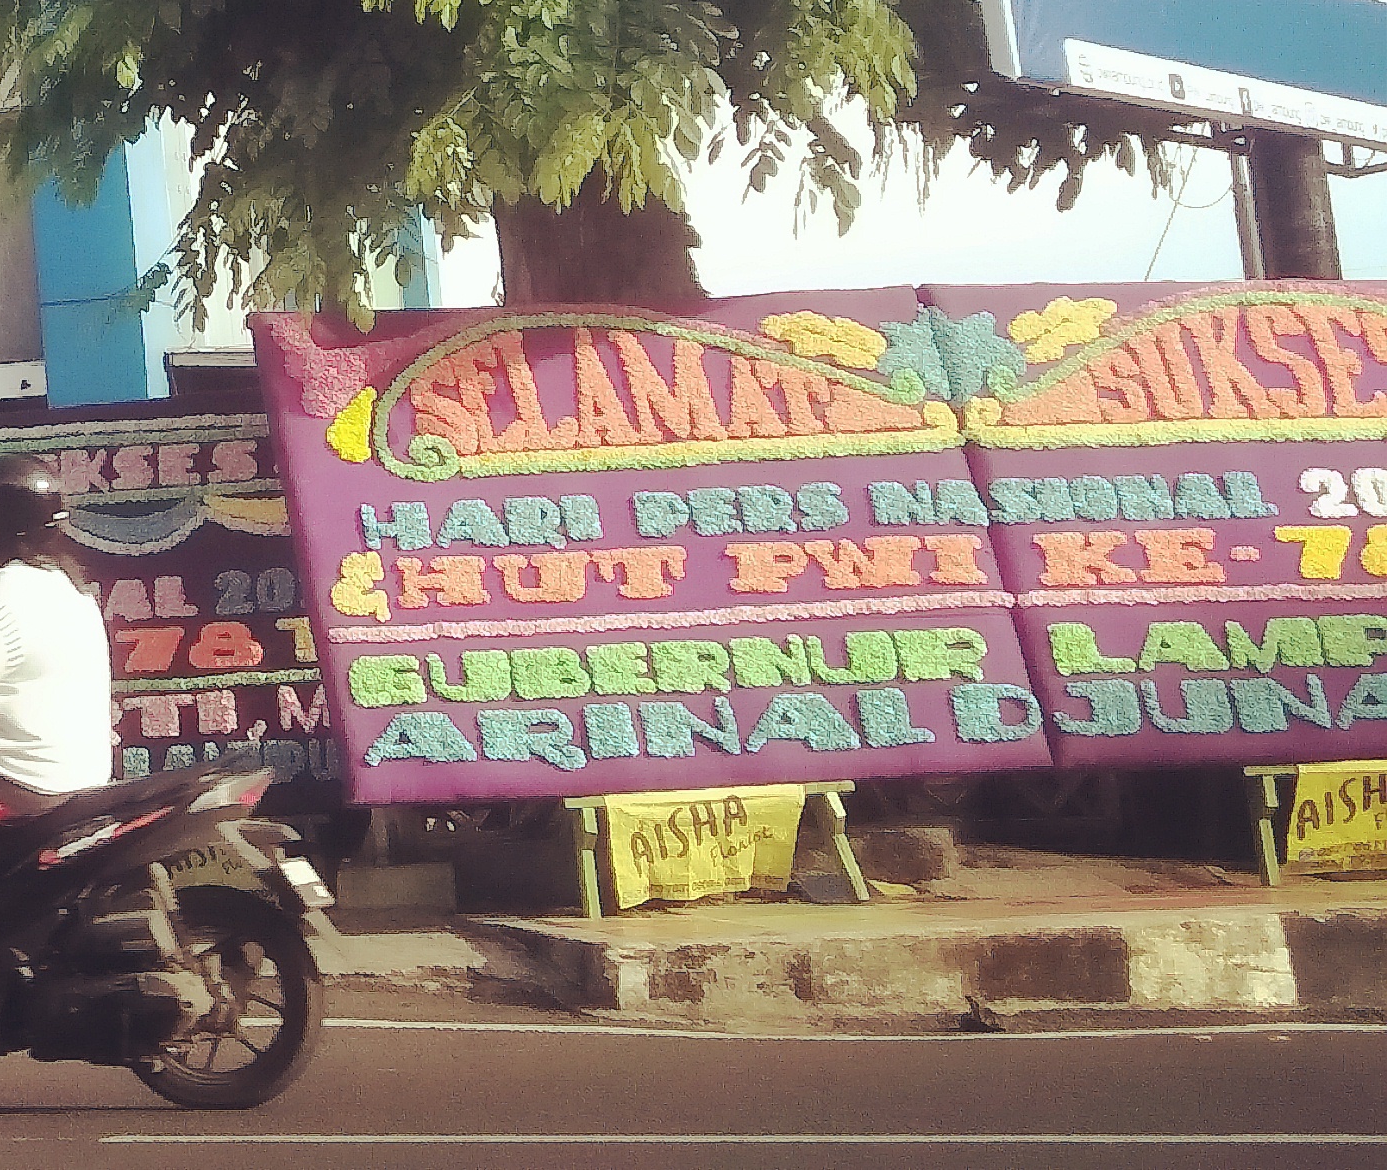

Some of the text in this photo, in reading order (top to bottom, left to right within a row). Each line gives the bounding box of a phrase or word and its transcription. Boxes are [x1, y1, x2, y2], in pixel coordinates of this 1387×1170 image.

[409, 329, 829, 454] SELAMAT
[33, 440, 258, 495] KSES
[359, 494, 605, 551] HARI
[633, 480, 850, 538] PERS
[867, 470, 1280, 528] NASIONAL
[329, 550, 391, 623] &
[396, 544, 687, 609] HUT
[725, 535, 990, 593] PWI
[114, 620, 264, 673] 78
[348, 626, 989, 709] GUBERNUR
[630, 794, 748, 880] AISHA
